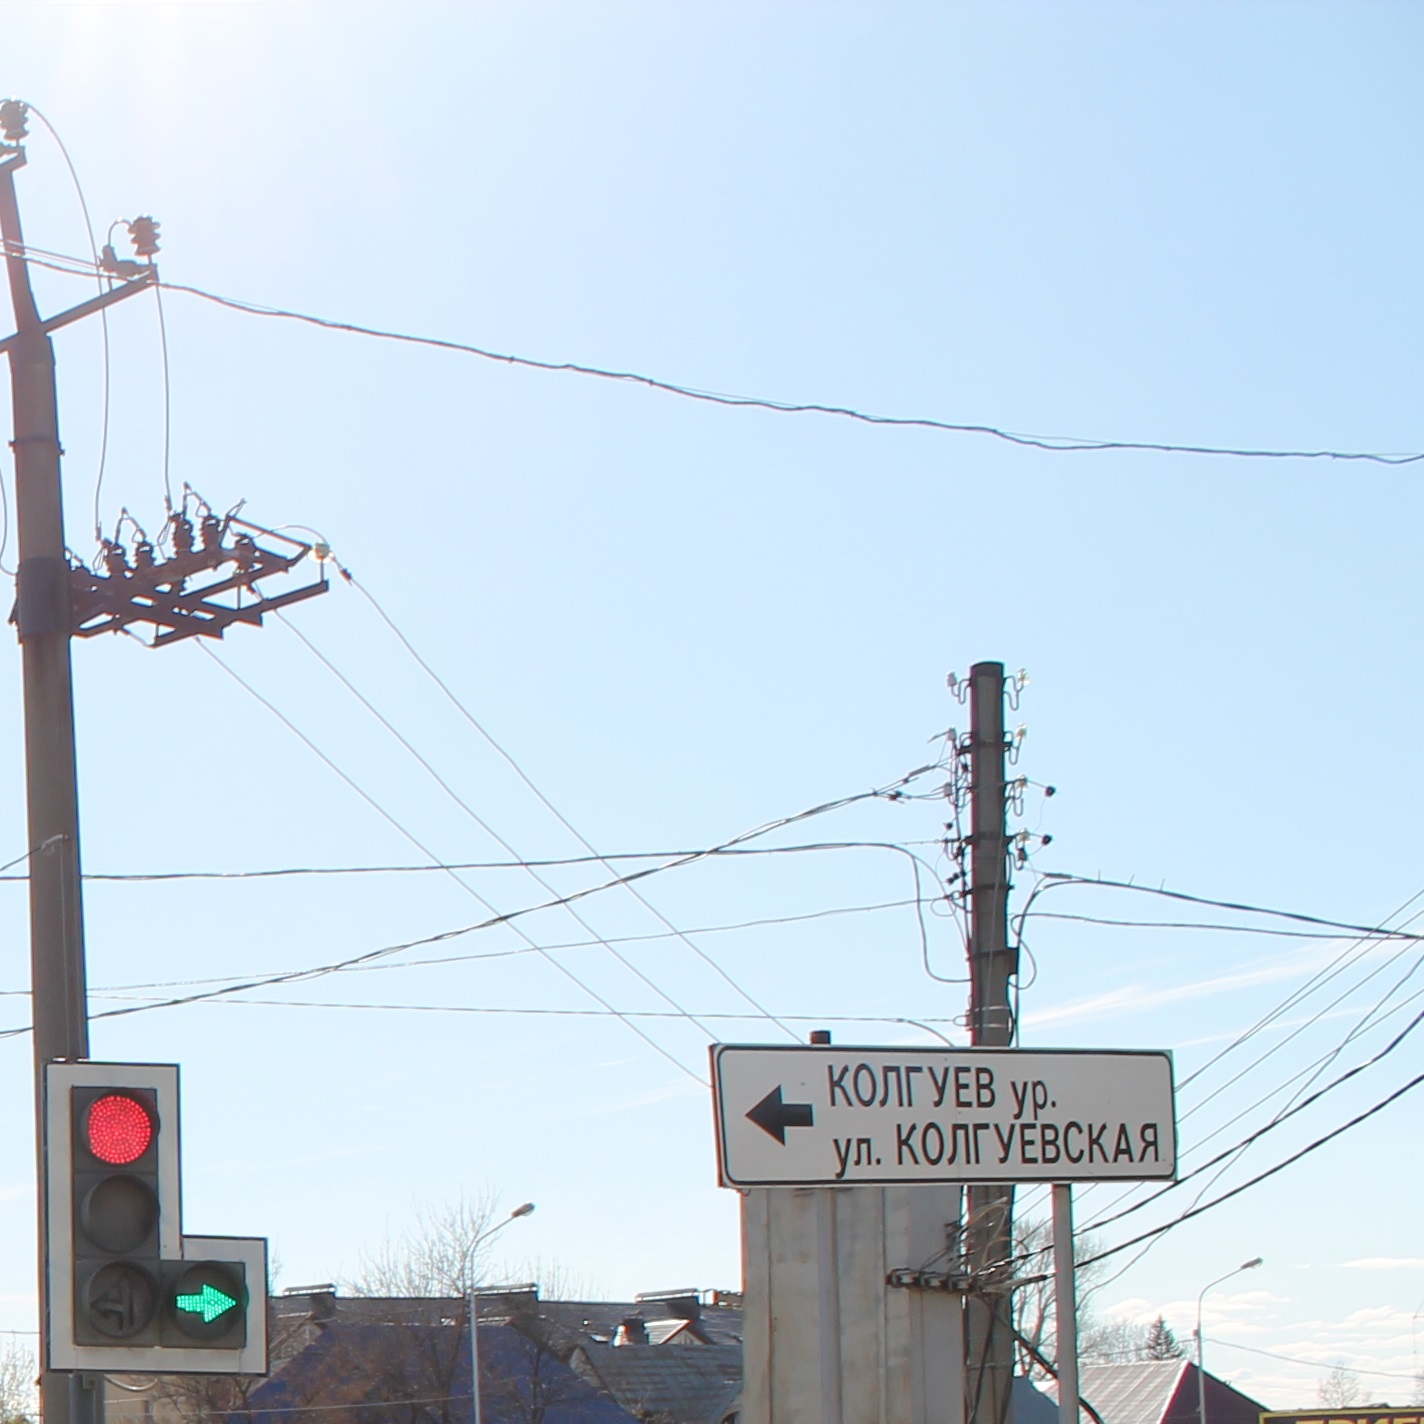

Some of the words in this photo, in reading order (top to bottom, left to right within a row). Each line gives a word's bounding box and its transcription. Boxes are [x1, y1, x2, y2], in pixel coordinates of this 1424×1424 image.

[827, 1062, 996, 1108] КОЛГУЕВ
[1010, 1080, 1057, 1121] ур.
[833, 1137, 881, 1179] ул.
[896, 1121, 1159, 1165] КОЛГУЕВСКАЯ
